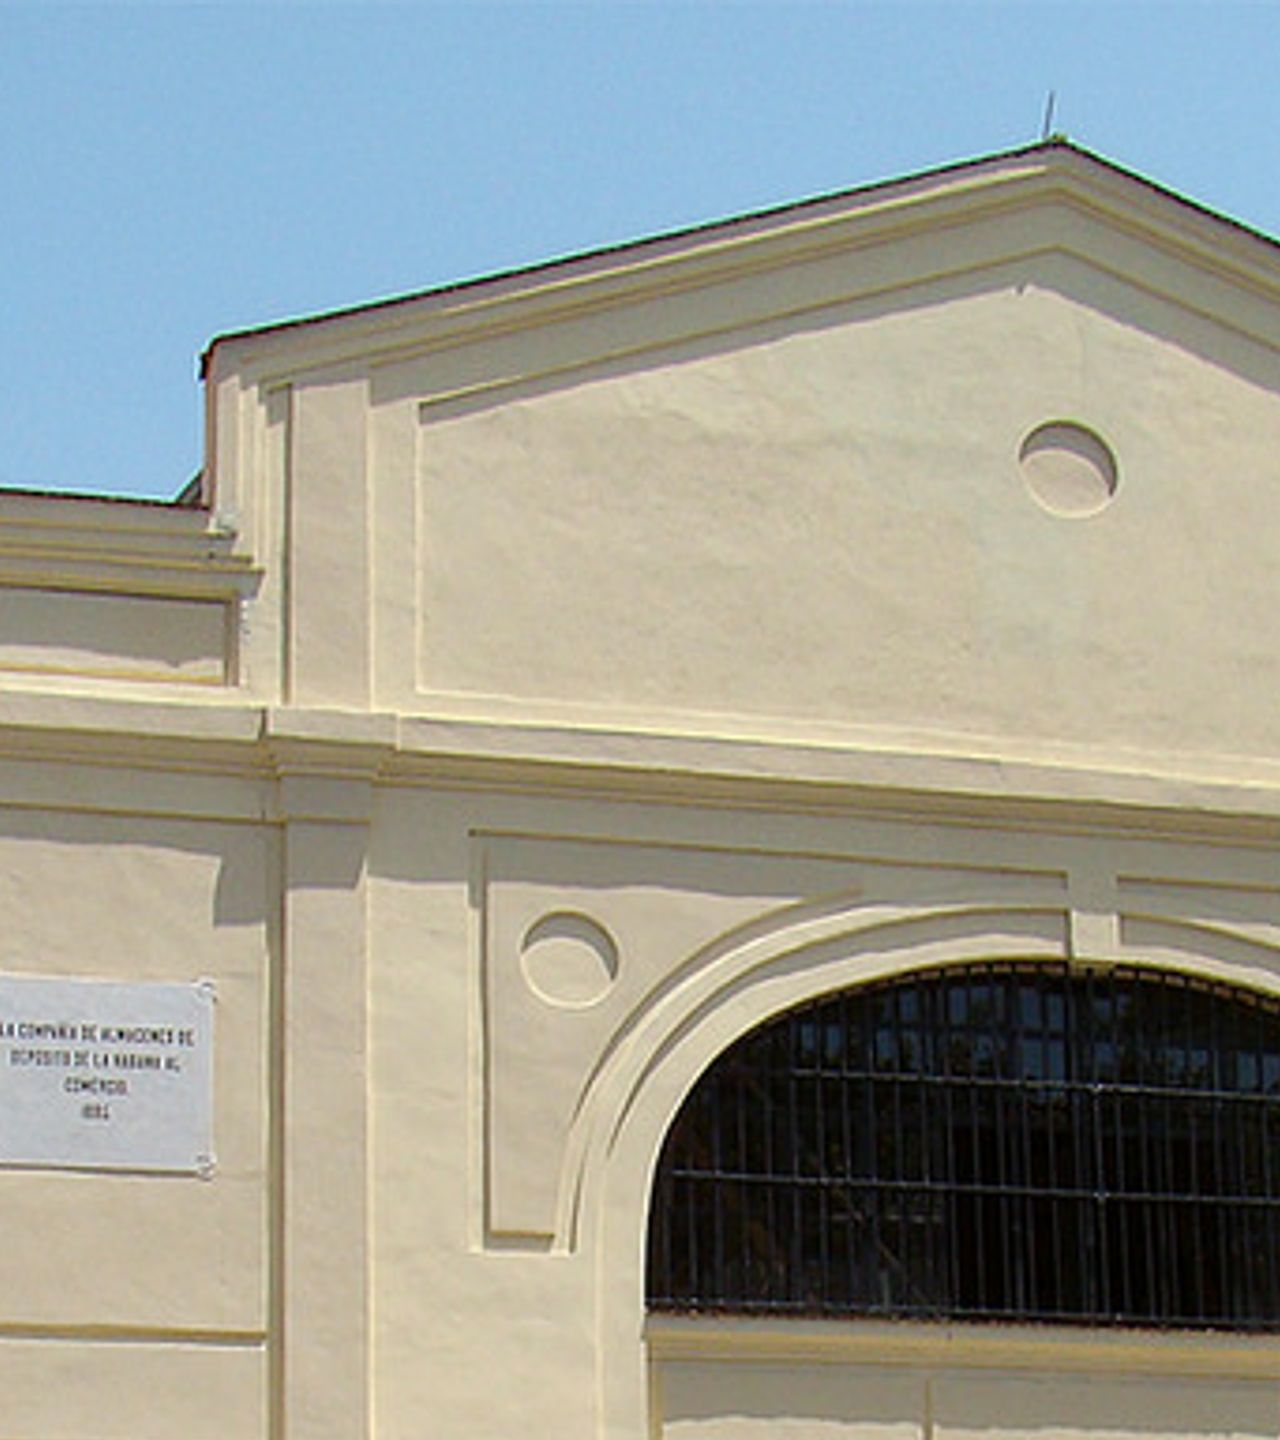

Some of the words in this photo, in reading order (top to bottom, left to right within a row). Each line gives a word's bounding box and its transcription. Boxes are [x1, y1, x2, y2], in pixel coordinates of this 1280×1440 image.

[81, 1025, 97, 1042] DE
[101, 1027, 173, 1045] ALMACENES
[178, 1029, 195, 1046] DE
[74, 1050, 89, 1067] DE
